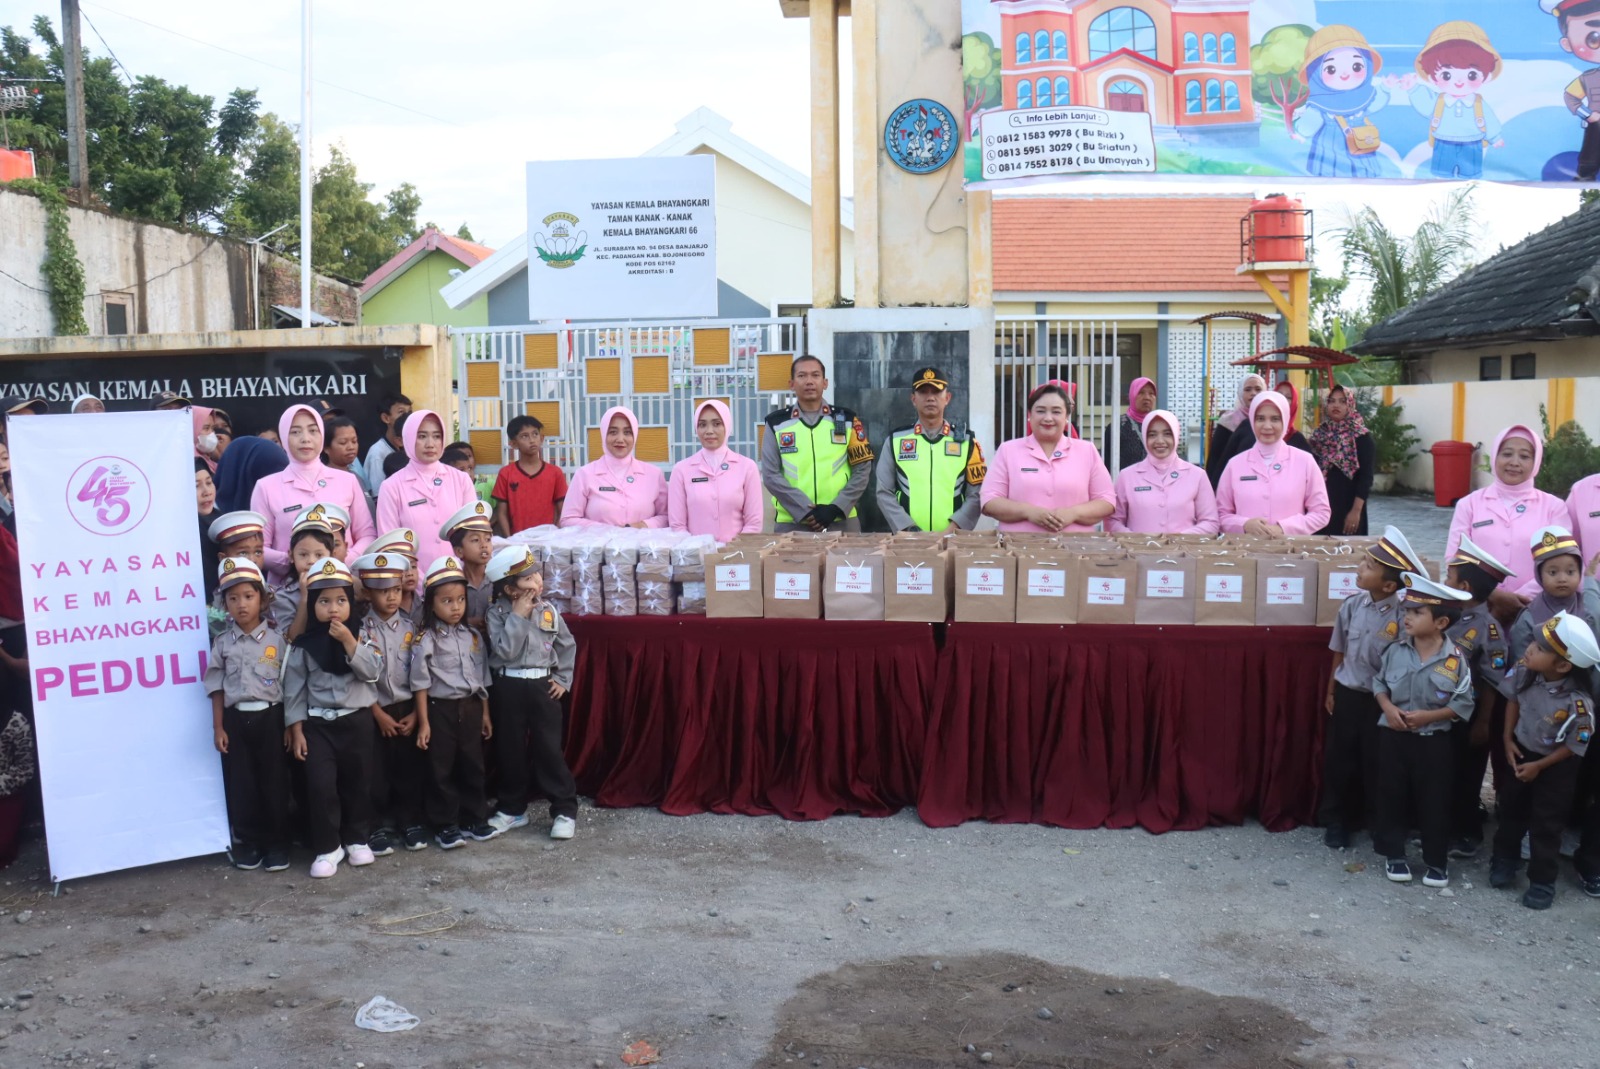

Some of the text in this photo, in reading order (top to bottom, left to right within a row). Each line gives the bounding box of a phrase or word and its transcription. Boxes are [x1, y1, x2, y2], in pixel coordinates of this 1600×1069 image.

[1071, 112, 1096, 121] Lanjut
[997, 134, 1020, 143] 0812
[1022, 131, 1045, 141] 1583
[1049, 129, 1072, 138] 9978
[1097, 130, 1117, 139] Rizki
[997, 148, 1020, 158] 0813
[1024, 145, 1045, 155] 5951
[1049, 143, 1072, 152] 3029
[1098, 143, 1130, 151] Sriatun
[1025, 160, 1048, 169] 7552
[1050, 157, 1073, 167] 8178
[1098, 156, 1143, 166] Umayyah
[591, 199, 710, 210] YAYASAN KEMALA BHAYANGKARI
[603, 228, 633, 236] KEMALA
[635, 227, 687, 235] BHAYANGKARI
[0, 374, 367, 401] YAYASAN KEMALA BHAYANGKARI
[77, 466, 130, 527] 45
[30, 551, 190, 579] YAYASAN
[33, 583, 196, 612] KEMALA
[36, 615, 200, 646] BHAYANGKARI
[35, 650, 207, 702] PEDULI
